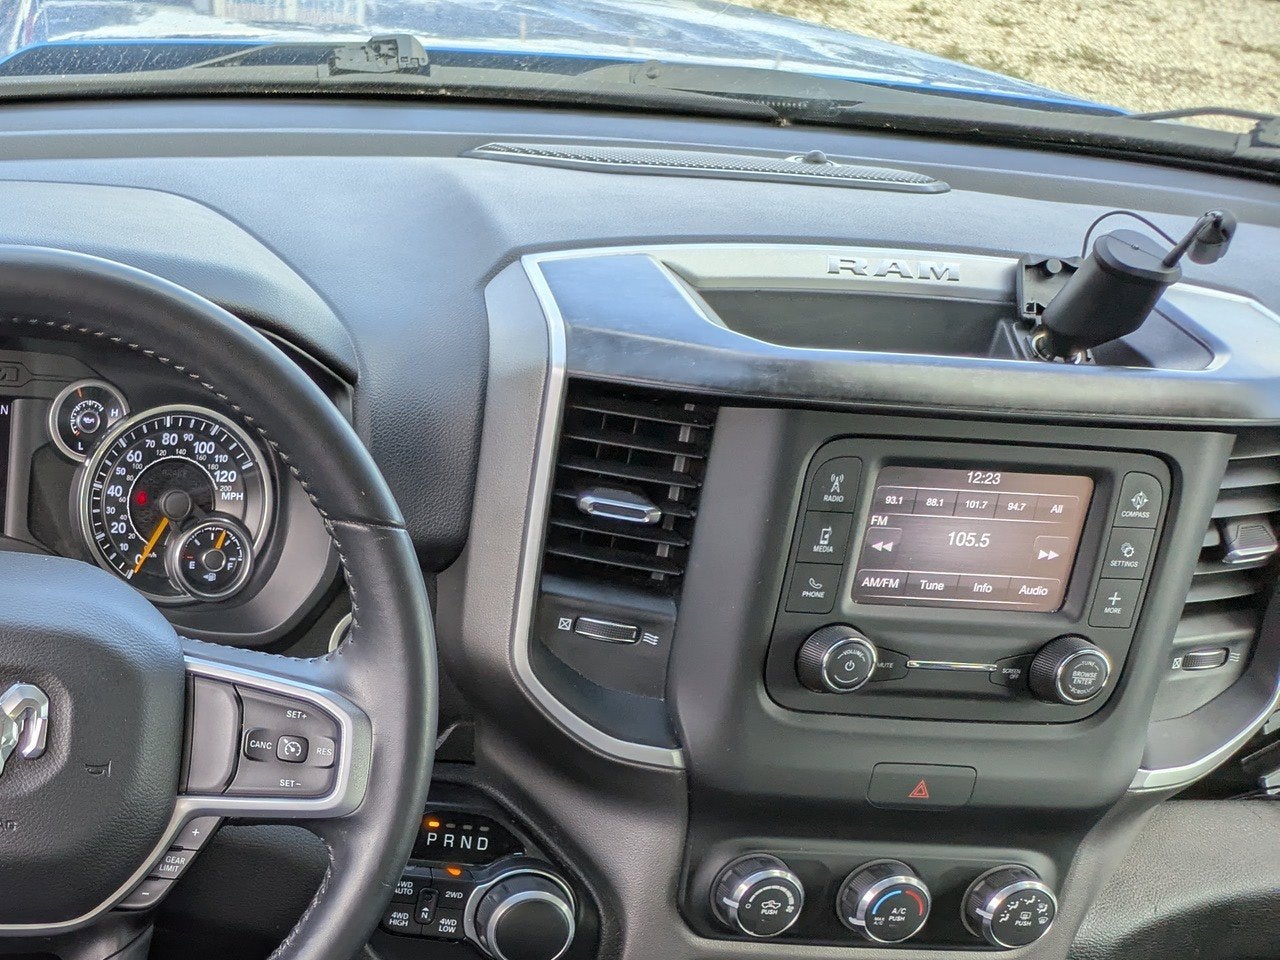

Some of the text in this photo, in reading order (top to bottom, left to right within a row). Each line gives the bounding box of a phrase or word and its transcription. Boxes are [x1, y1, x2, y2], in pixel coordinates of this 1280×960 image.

[827, 255, 960, 282] RAM
[0, 404, 9, 415] N
[110, 408, 119, 418] H
[162, 433, 178, 446] 80
[183, 433, 194, 442] 90
[78, 442, 84, 450] L
[145, 439, 156, 448] 70
[193, 441, 215, 454] 100
[126, 450, 142, 463] 60
[156, 449, 167, 457] 120
[175, 448, 187, 456] 140
[214, 454, 229, 463] 110
[115, 467, 126, 475] 50
[207, 463, 219, 471] 180
[214, 470, 236, 483] 120
[966, 471, 1001, 485] 12:23
[107, 485, 122, 497] 40
[221, 492, 244, 501] MPH
[823, 494, 844, 503] RADIO
[885, 495, 904, 505] 93.1
[926, 497, 944, 507] 88.1
[965, 499, 989, 510] 101.7
[1007, 501, 1027, 512] 94.7
[105, 506, 116, 515] 30
[1049, 504, 1063, 514] All
[1121, 510, 1150, 519] COMPASS
[870, 515, 889, 527] FM
[110, 522, 126, 534] 20
[947, 531, 991, 548] 105.5
[120, 543, 129, 551] 10
[813, 545, 834, 553] MEDIA
[188, 561, 196, 570] E
[227, 562, 234, 571] F
[1110, 560, 1139, 568] SETTINGS
[861, 577, 900, 590] AM/FM
[919, 579, 945, 592] Tune
[973, 582, 993, 594] Info
[801, 590, 825, 599] PHONE
[1018, 584, 1049, 597] Audio
[1104, 606, 1122, 615] MORE
[842, 649, 865, 658] VOLUME
[1072, 670, 1098, 679] BROWSE
[249, 739, 272, 750] CANC
[316, 747, 332, 757] RES
[165, 856, 186, 865] GEAR
[159, 864, 180, 873] LIMIT
[445, 890, 463, 899] 2WD
[391, 911, 409, 919] 4WD
[891, 907, 907, 915] A/C
[388, 918, 409, 926] HIGH
[439, 917, 457, 926] 4WD
[438, 925, 456, 933] LOW
